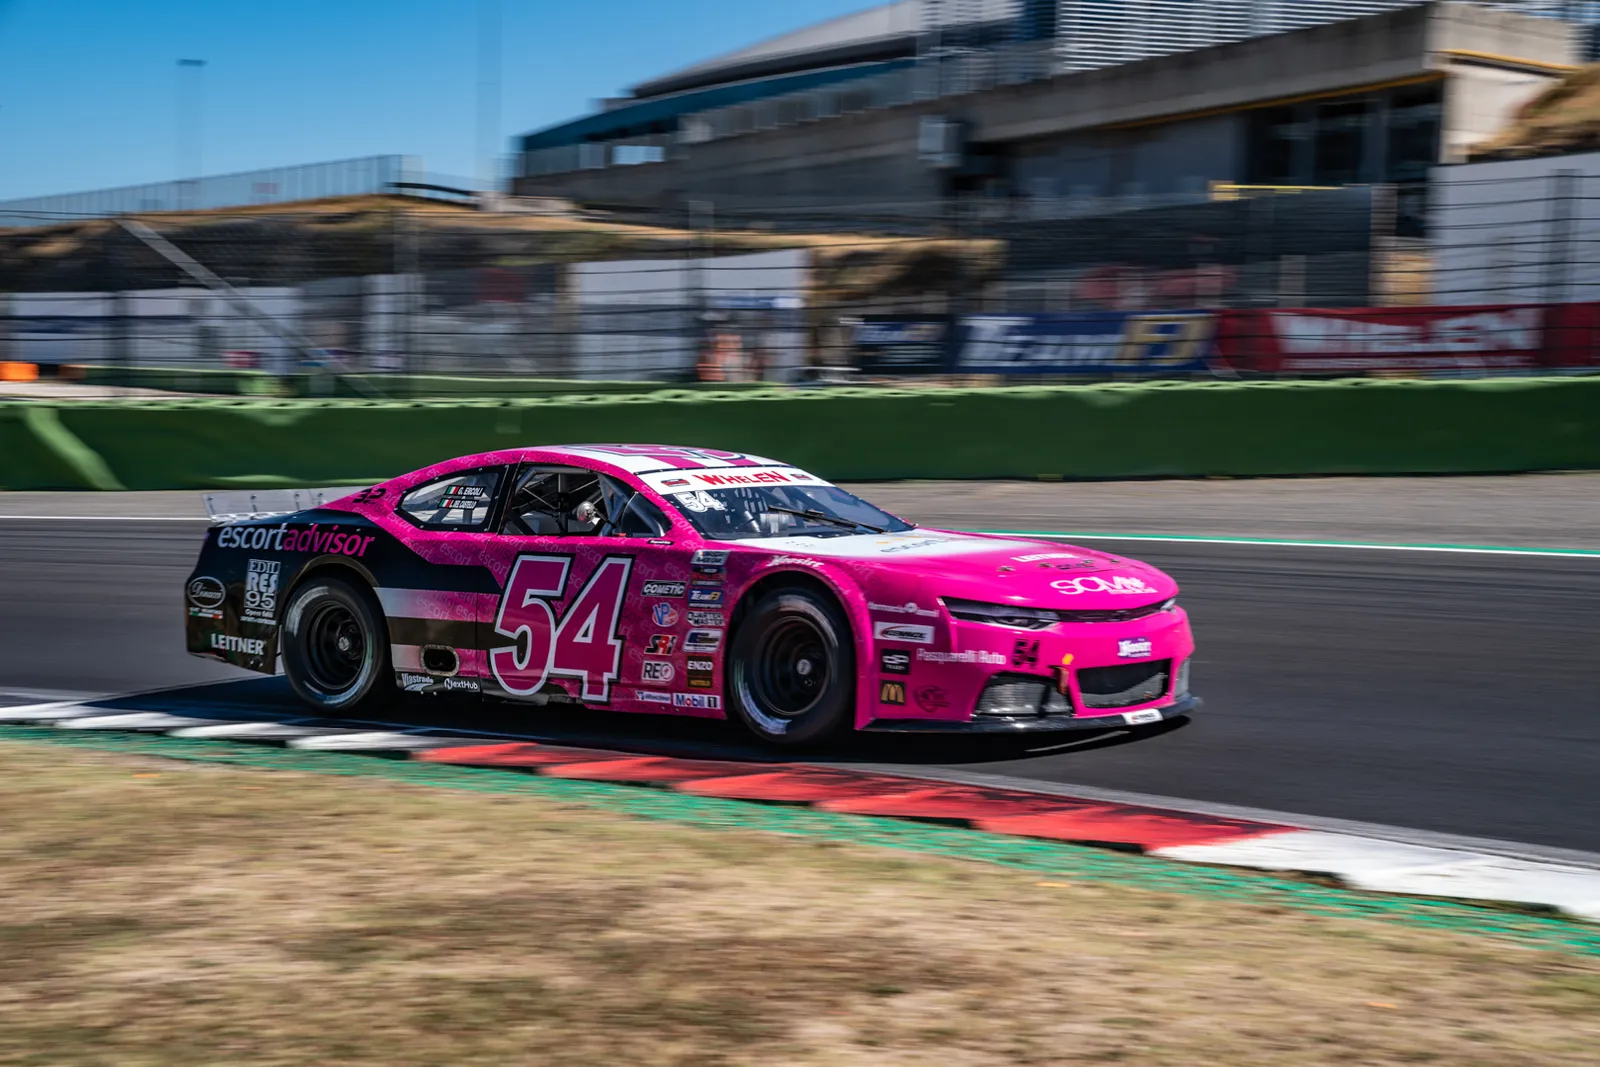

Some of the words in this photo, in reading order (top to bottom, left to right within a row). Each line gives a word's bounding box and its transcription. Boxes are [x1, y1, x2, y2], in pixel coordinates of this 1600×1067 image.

[692, 471, 791, 486] WHELEN
[464, 487, 484, 497] ERCOLI
[673, 490, 726, 513] 54
[217, 523, 376, 557] escortadvisor
[249, 561, 280, 574] EDIL
[247, 572, 279, 594] RES
[644, 583, 685, 595] COMETIC
[245, 591, 275, 609] 95
[652, 602, 671, 626] VP
[489, 552, 635, 705] 54
[210, 633, 265, 655] LEITNER
[1012, 639, 1040, 669] 54
[687, 661, 713, 671] ENZO
[401, 673, 434, 687] Viastrade
[444, 678, 479, 690] NextHub
[676, 694, 705, 707] Mobil
